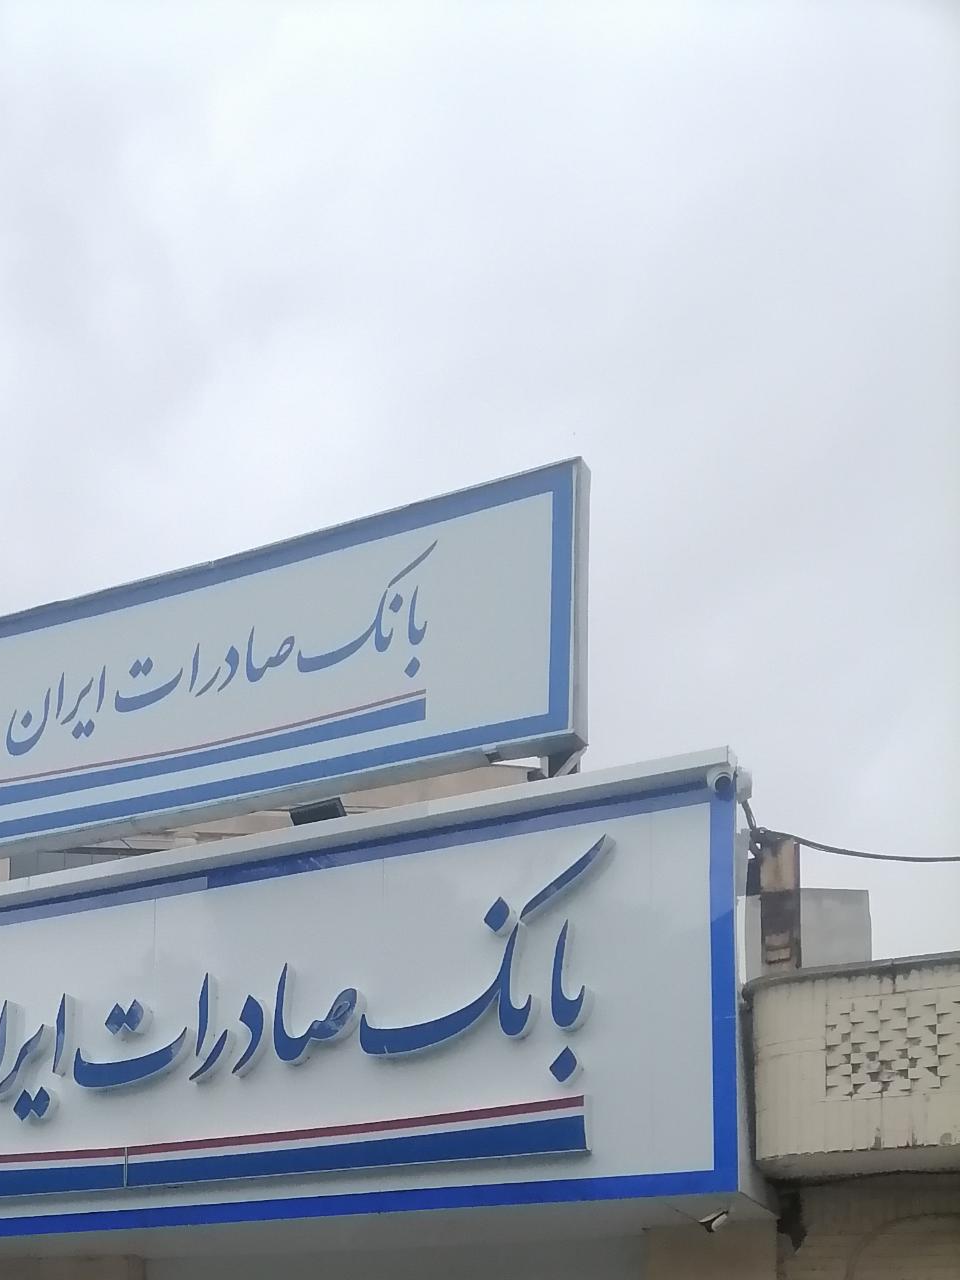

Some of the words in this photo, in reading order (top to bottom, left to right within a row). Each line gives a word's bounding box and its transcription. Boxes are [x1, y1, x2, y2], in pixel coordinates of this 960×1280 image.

[115, 625, 297, 713] صادرات
[298, 540, 438, 679] بانک
[5, 664, 106, 757] ایران
[359, 834, 608, 1084] بانک
[73, 962, 364, 1089] صادرات
